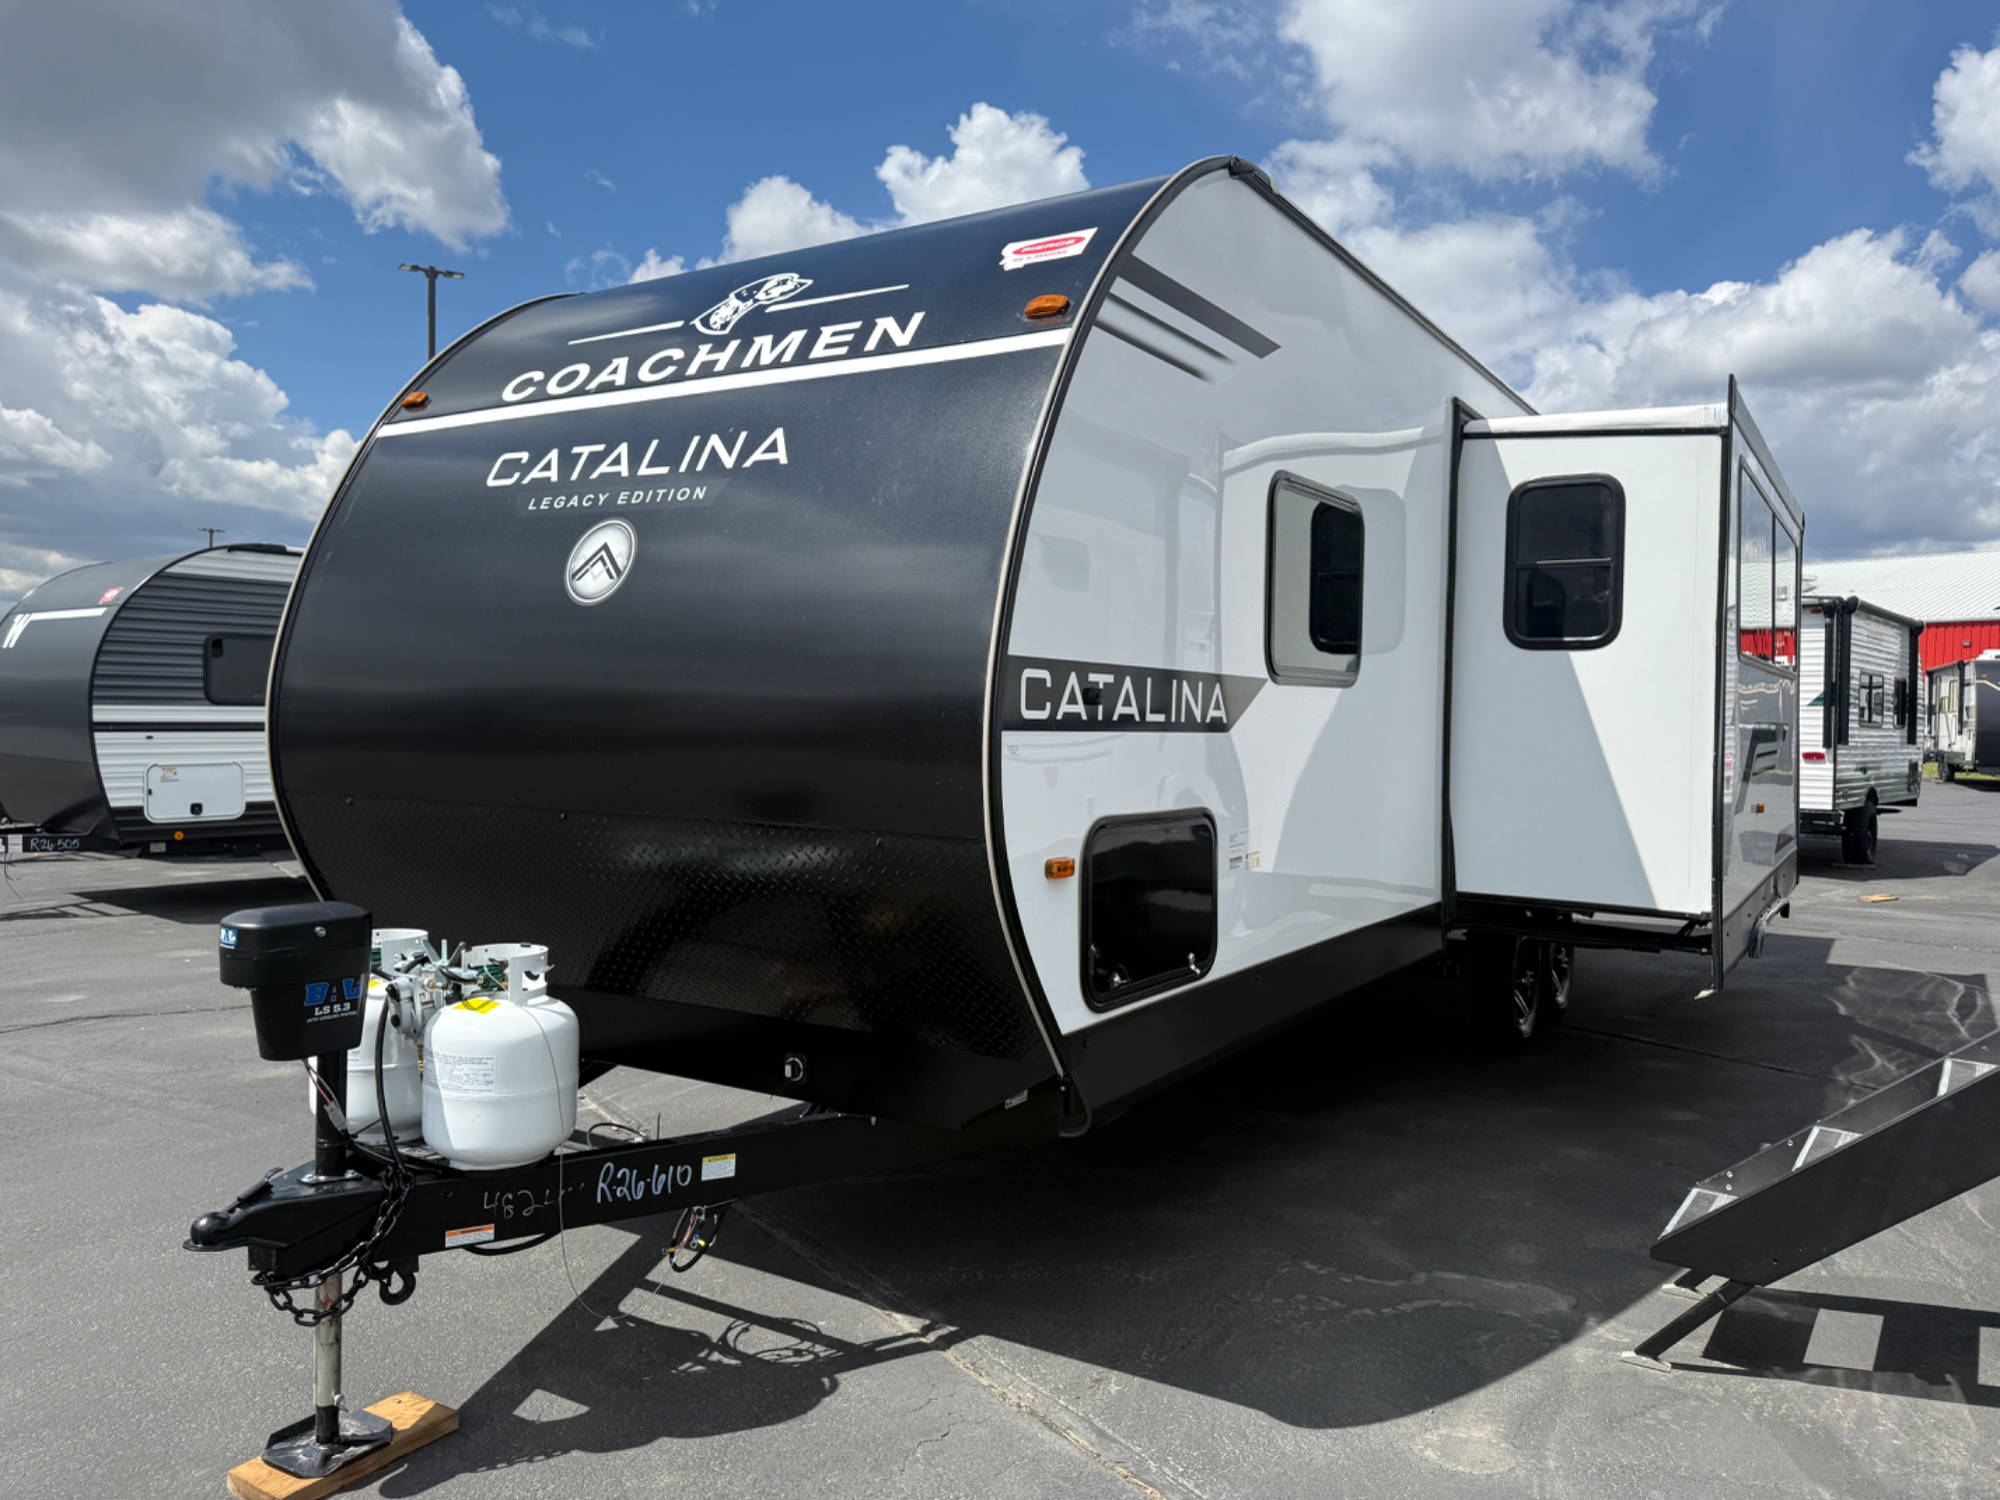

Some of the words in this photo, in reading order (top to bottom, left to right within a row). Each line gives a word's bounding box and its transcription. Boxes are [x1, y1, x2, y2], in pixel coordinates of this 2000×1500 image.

[501, 311, 926, 402] COACHMEN
[486, 427, 789, 487] CATALINA
[528, 495, 610, 511] LEGACY
[617, 485, 707, 505] EDITION
[1020, 668, 1228, 723] CATALINA
[314, 1005, 331, 1016] LS
[332, 1002, 351, 1013] 5.3
